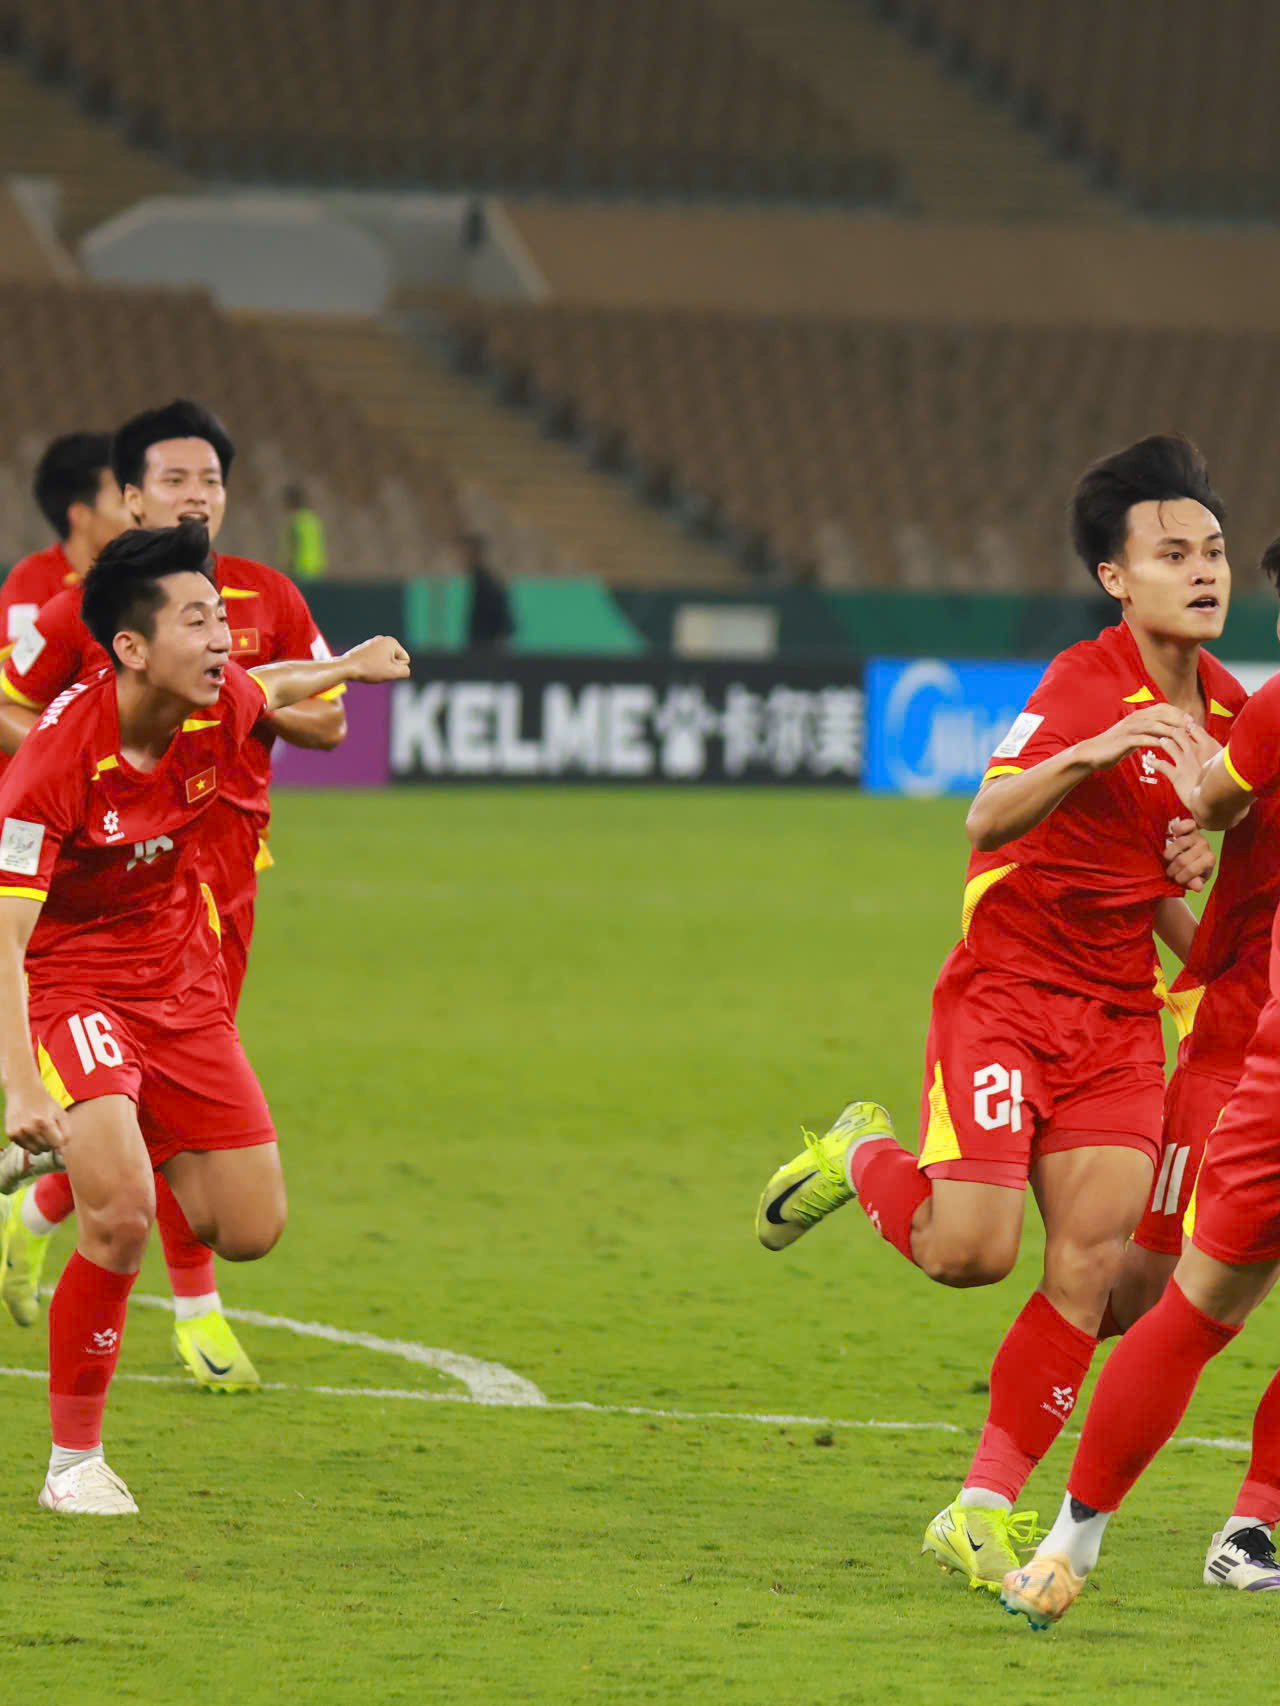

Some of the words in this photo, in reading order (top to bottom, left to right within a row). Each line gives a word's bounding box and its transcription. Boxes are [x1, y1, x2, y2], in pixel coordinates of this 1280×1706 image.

[391, 680, 657, 776] KELME
[67, 1010, 124, 1075] 16
[973, 1062, 1025, 1133] 21
[1150, 1143, 1191, 1216] 11
